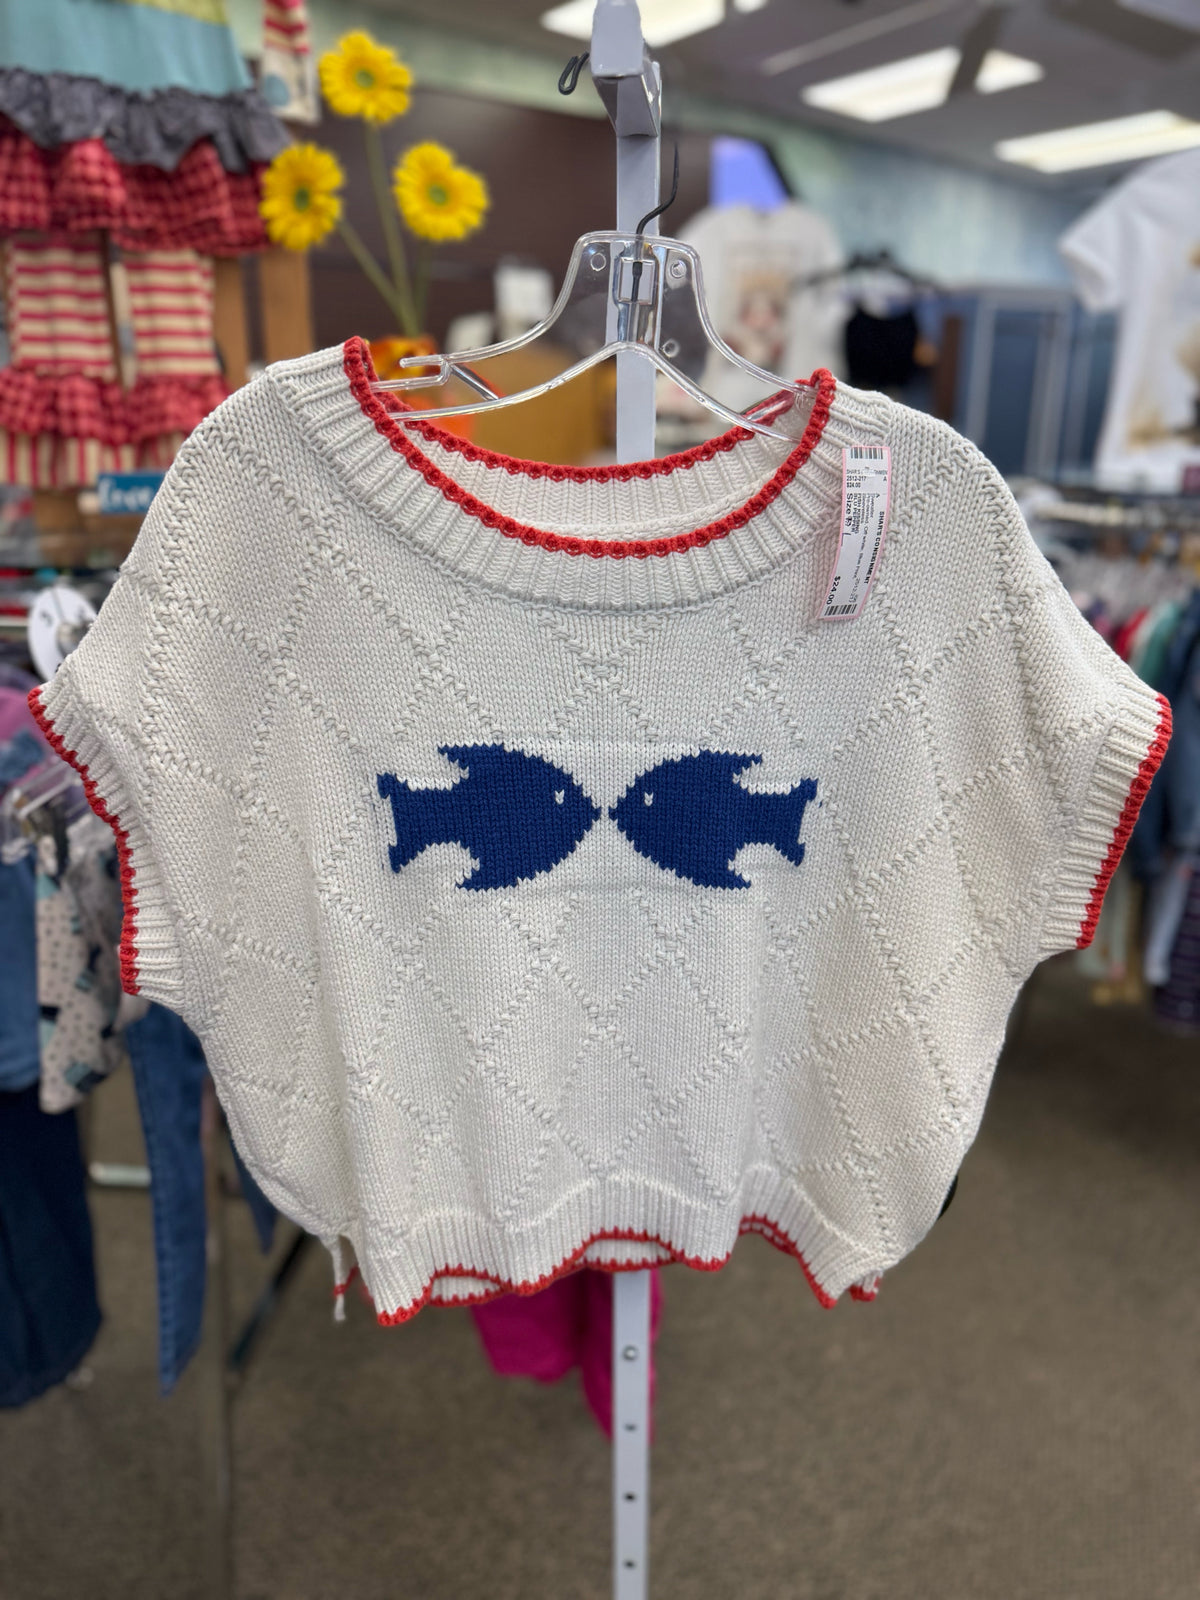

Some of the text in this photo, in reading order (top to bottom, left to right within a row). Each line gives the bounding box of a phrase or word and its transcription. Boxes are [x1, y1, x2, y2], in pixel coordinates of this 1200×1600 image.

[863, 511, 885, 584] SHAR'S CONSIGNMENT
[826, 575, 841, 605] $24.00
